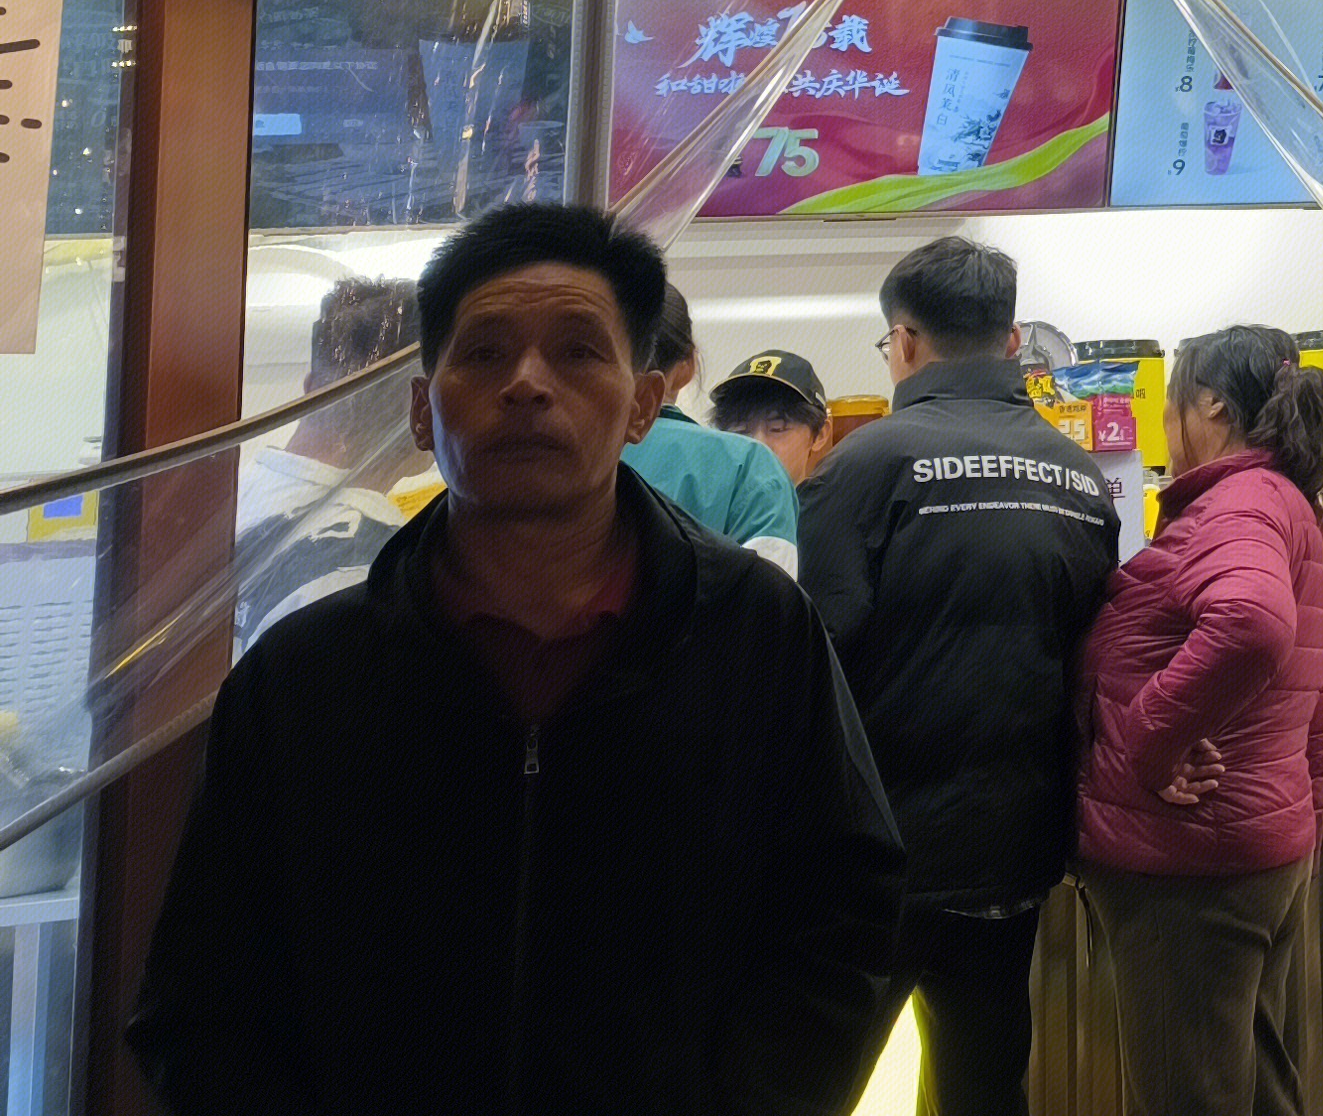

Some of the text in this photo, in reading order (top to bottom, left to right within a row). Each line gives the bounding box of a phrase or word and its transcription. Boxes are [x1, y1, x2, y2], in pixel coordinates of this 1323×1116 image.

[753, 127, 820, 177] 75
[913, 455, 1100, 497] SIDEEFFECT/SID
[950, 502, 978, 513] EVERY
